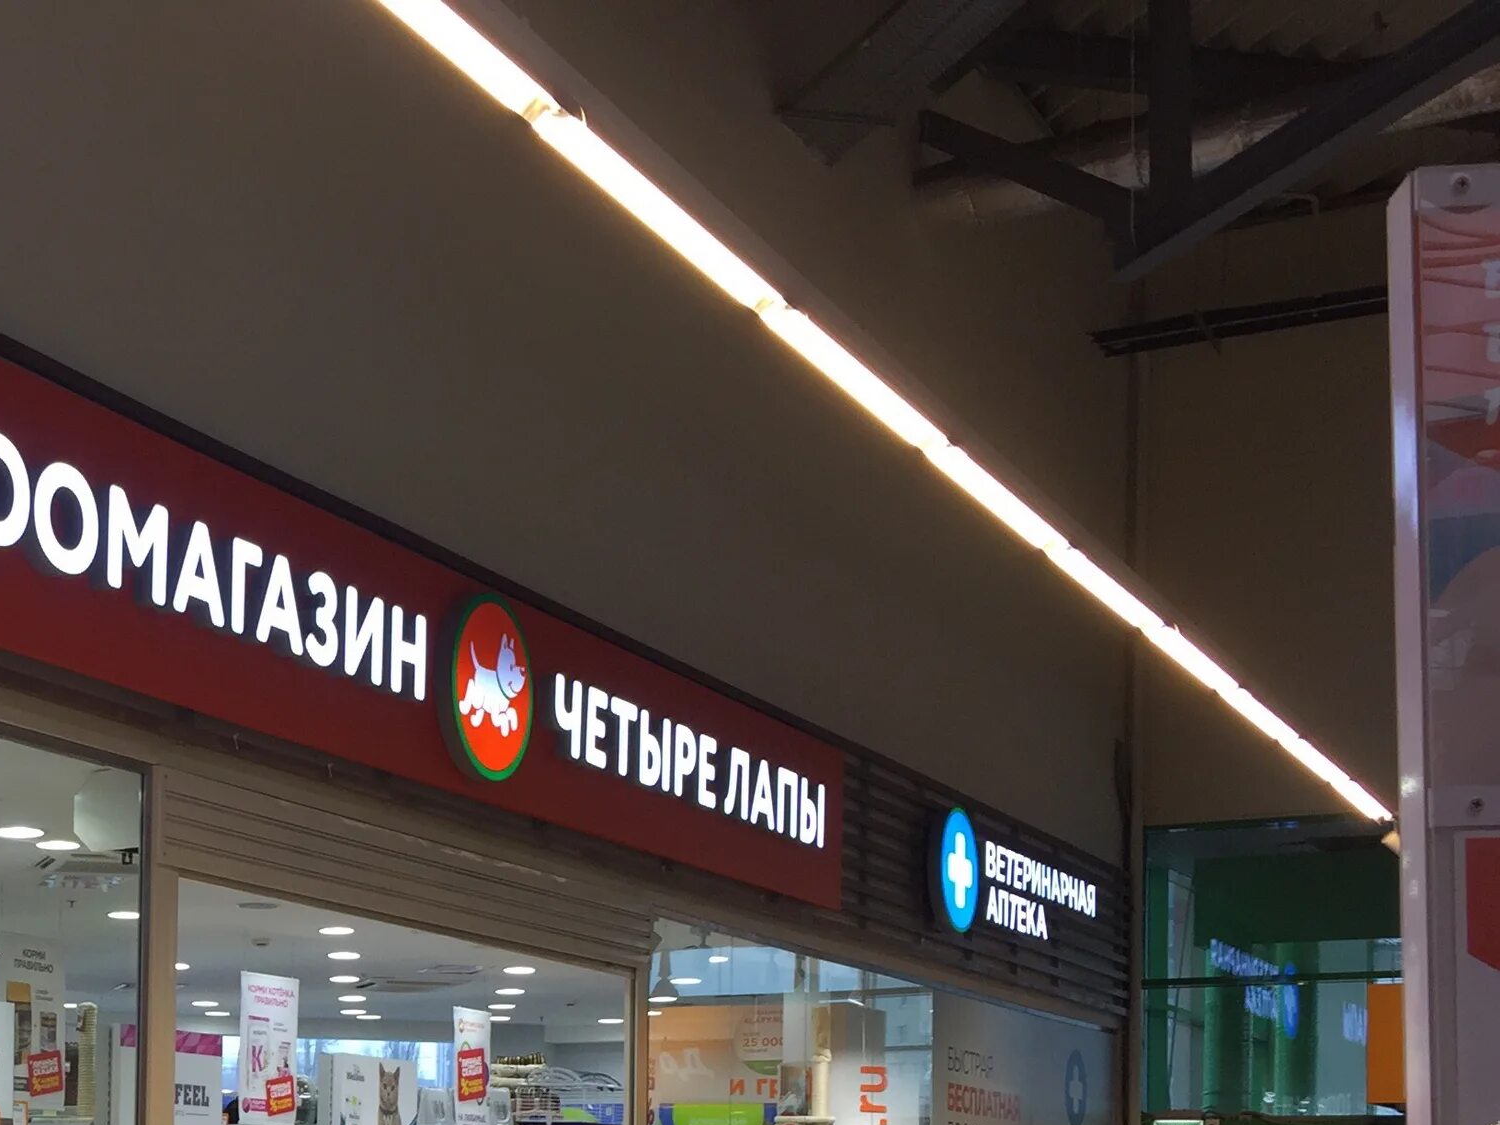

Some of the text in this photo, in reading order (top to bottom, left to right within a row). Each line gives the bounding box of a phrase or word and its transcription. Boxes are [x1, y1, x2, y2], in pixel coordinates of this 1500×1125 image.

[554, 673, 826, 849] ЧЕТЫРЕ ЛАПЫ
[985, 840, 1096, 918] ВЕТЕРИНАРНАЯ
[986, 885, 1049, 940] АПТЕКА
[743, 1038, 758, 1048] 25
[175, 1083, 209, 1107] FEEL
[947, 1082, 1022, 1122] БЕСПЛАТНАЯ
